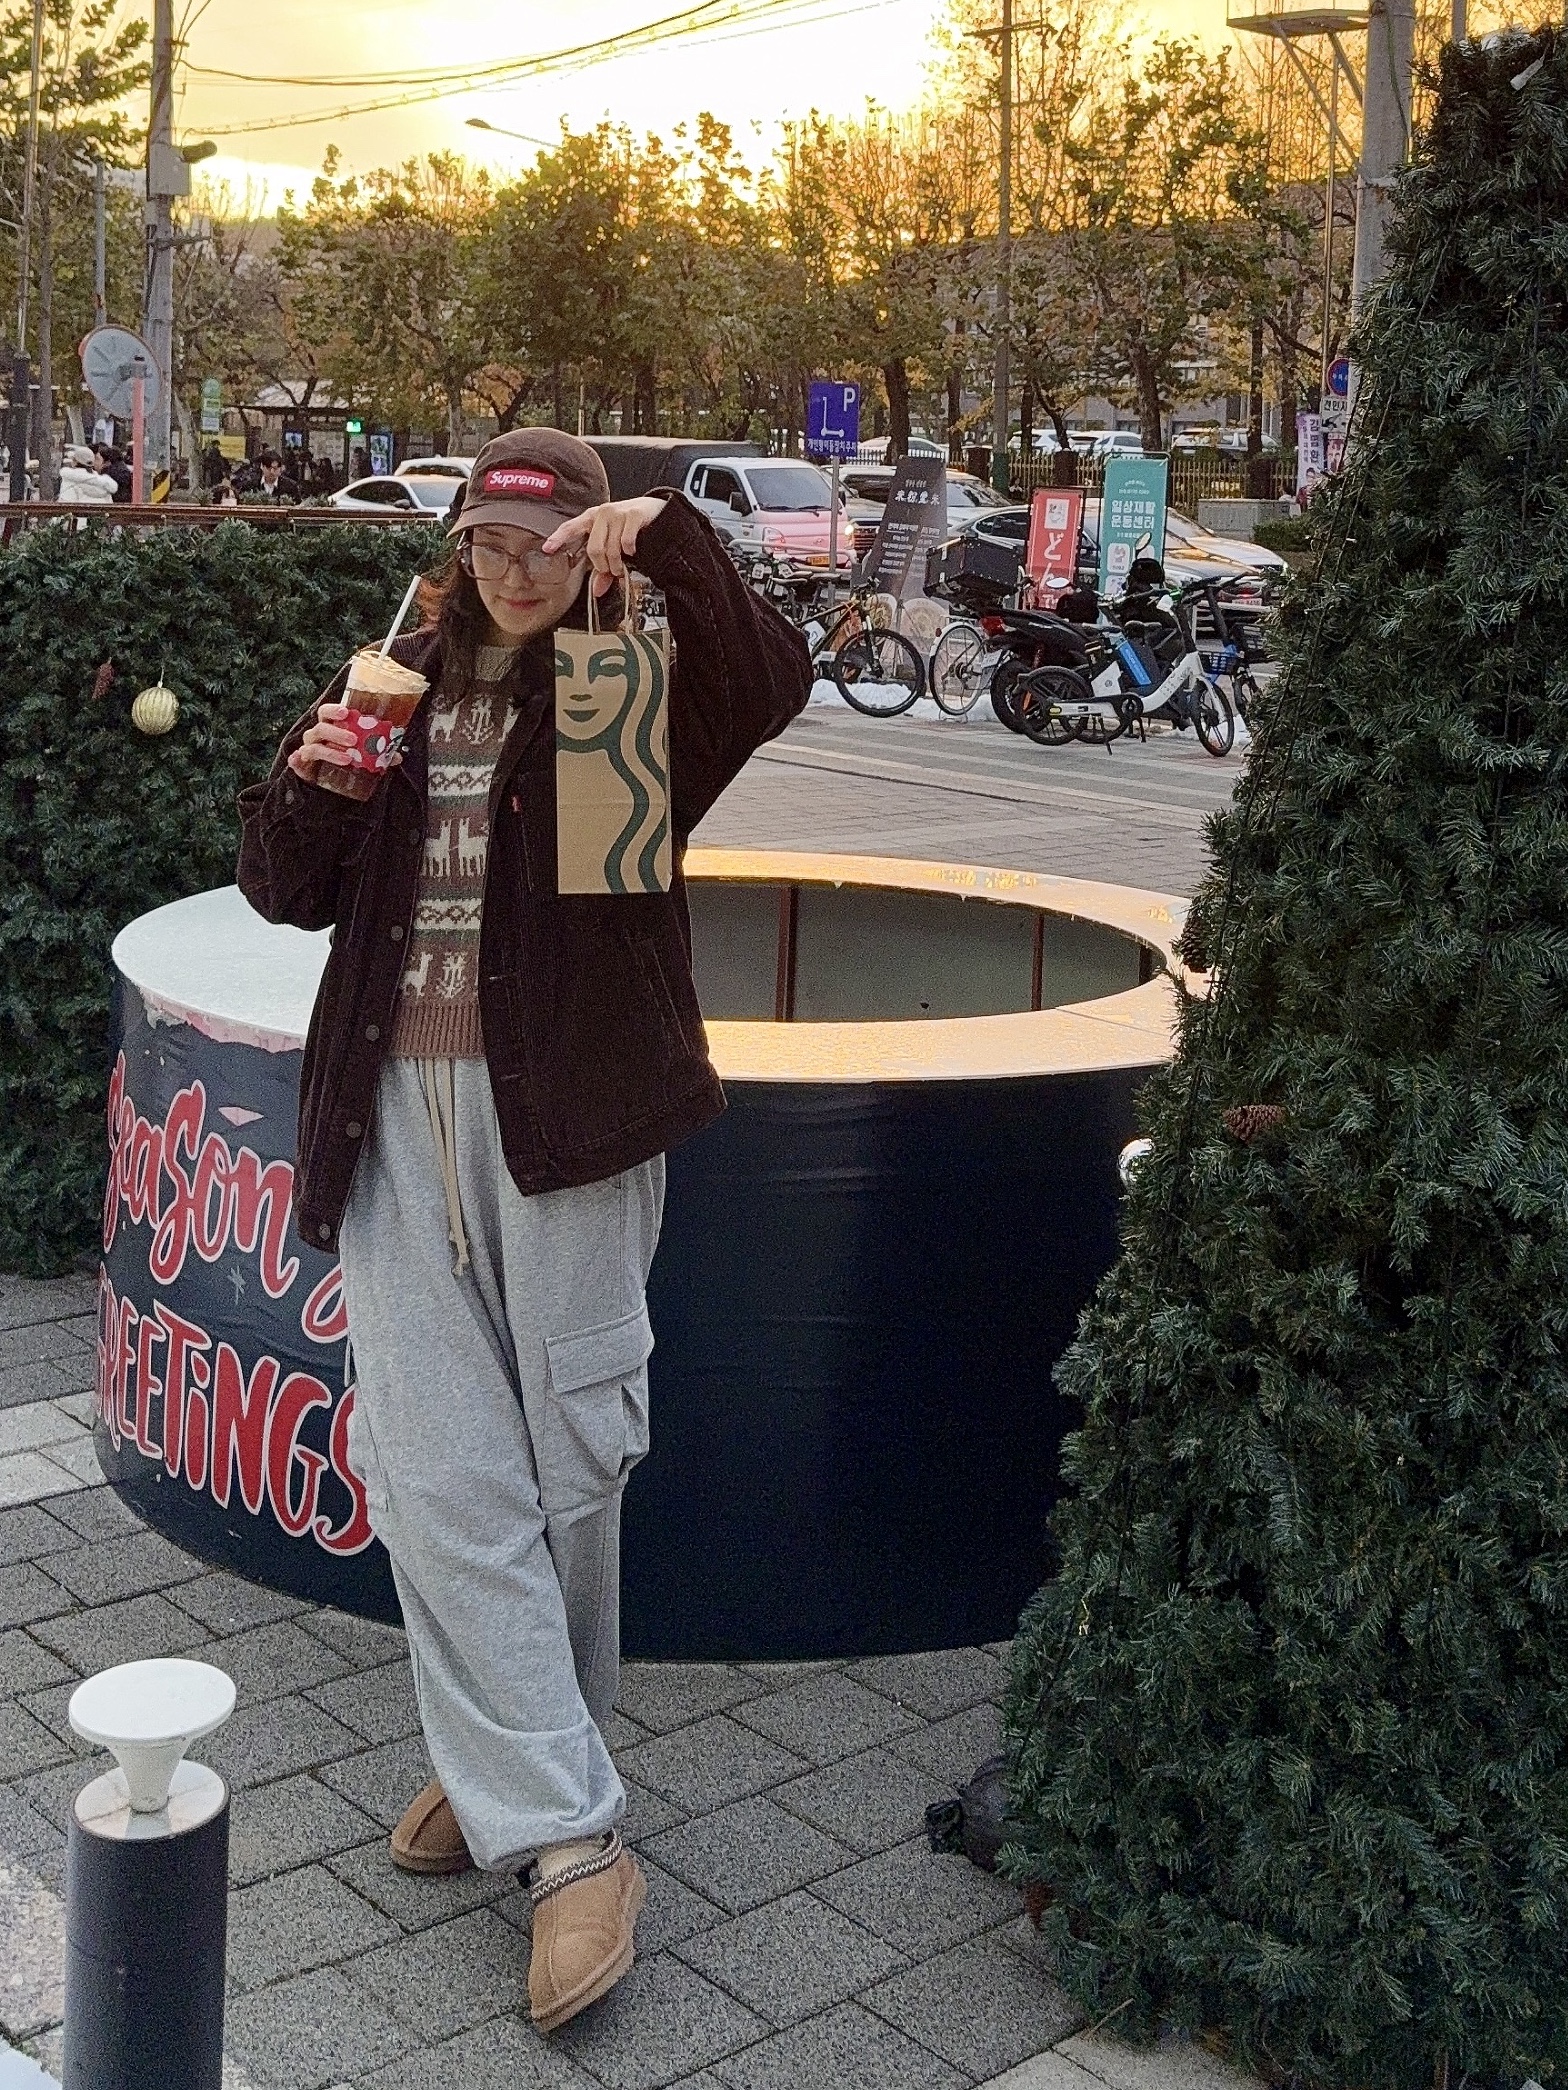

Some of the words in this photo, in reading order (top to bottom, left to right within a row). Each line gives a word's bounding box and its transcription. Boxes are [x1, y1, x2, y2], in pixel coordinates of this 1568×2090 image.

[843, 387, 856, 412] P
[1324, 400, 1348, 412] 견인지
[489, 471, 549, 489] Supreme
[1111, 500, 1156, 515] 일상재활
[1111, 514, 1154, 529] 운동센터
